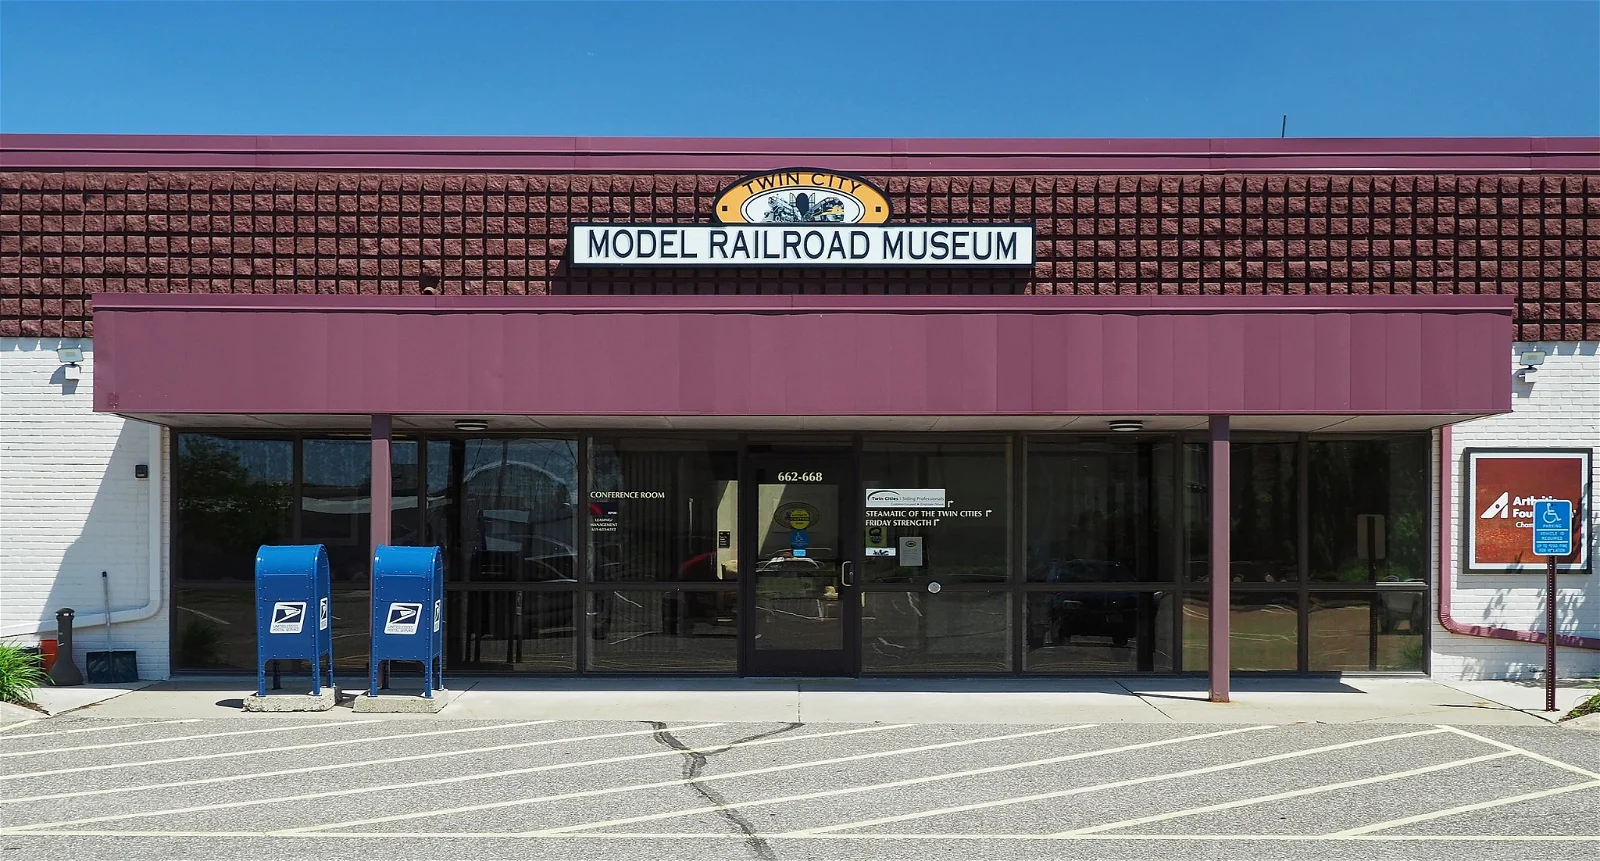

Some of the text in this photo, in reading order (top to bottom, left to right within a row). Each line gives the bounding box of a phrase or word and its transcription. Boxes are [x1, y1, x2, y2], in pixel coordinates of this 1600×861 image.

[742, 172, 863, 194] TWIN CITY
[587, 229, 1018, 260] MODEL RAILROAD MUSEUM
[778, 471, 823, 482] 662-668
[590, 491, 665, 499] CONFERENCE ROOM
